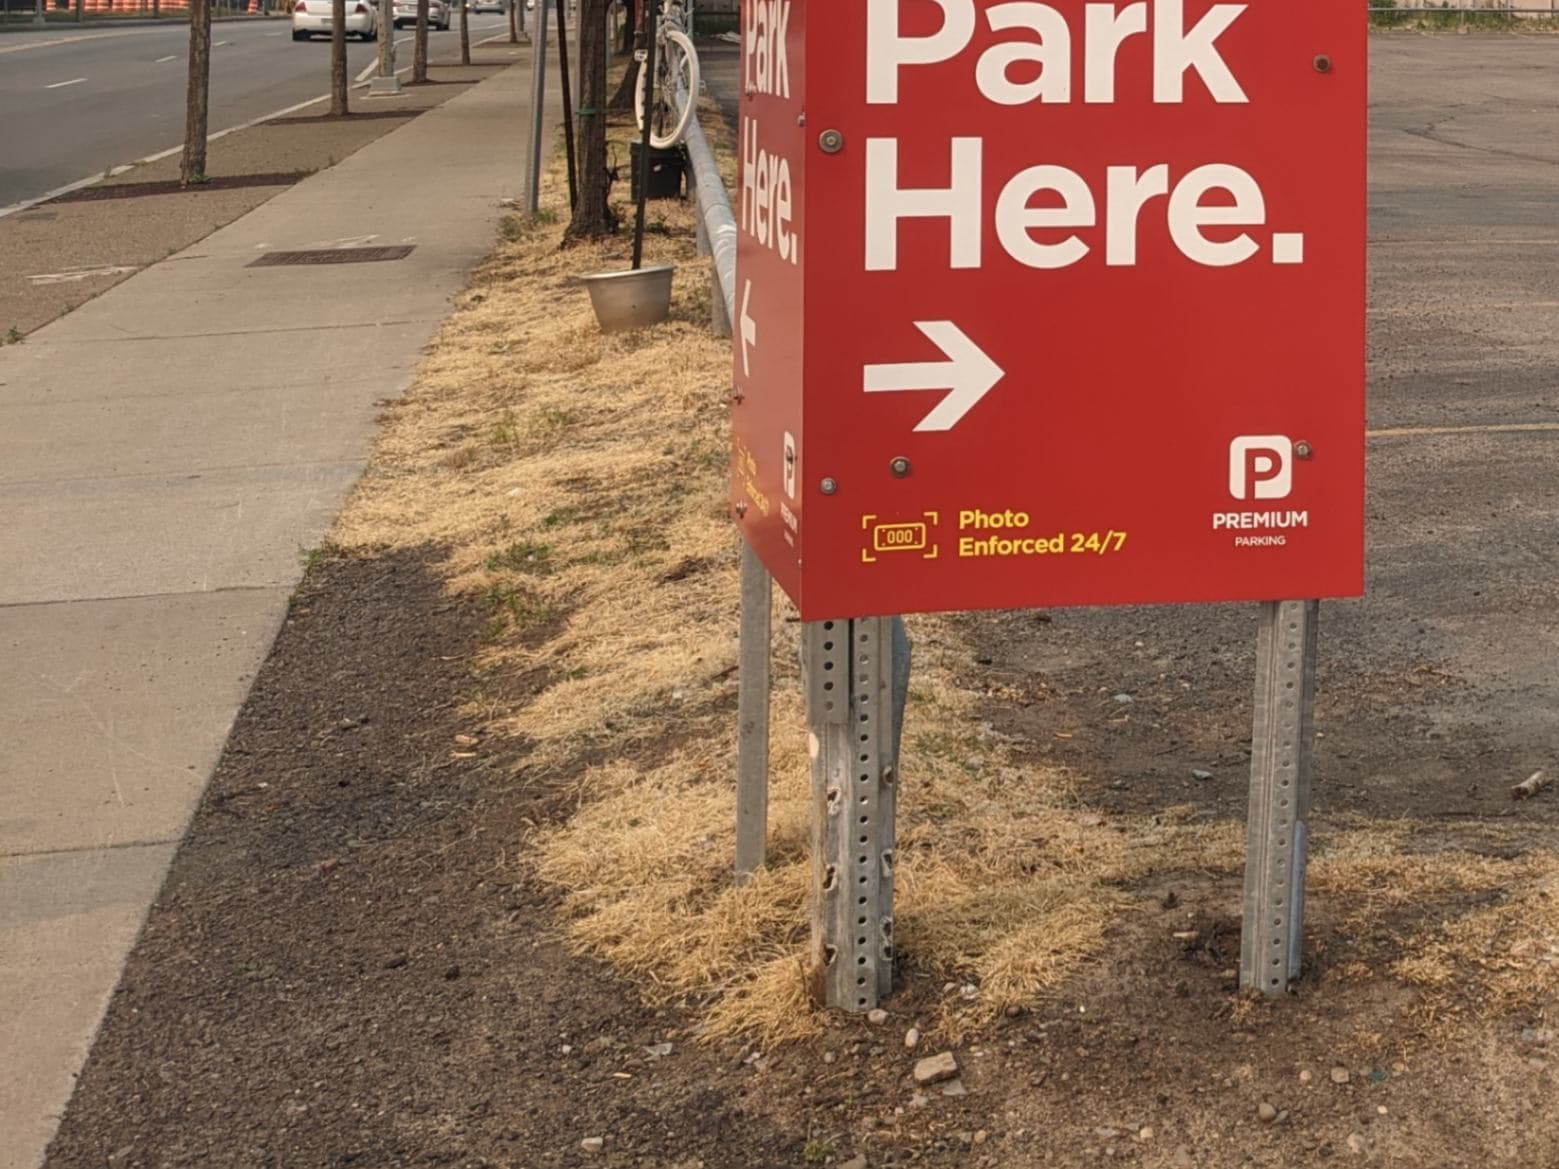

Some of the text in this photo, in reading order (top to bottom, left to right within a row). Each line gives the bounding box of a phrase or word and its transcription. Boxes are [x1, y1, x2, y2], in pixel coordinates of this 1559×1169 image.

[742, 115, 798, 266] Here.
[865, 136, 1304, 270] Here.
[959, 509, 1030, 530] Photo
[1212, 510, 1308, 530] PREMIUM
[959, 530, 1127, 557] Enforced 24/7
[1235, 535, 1286, 546] PARKING
